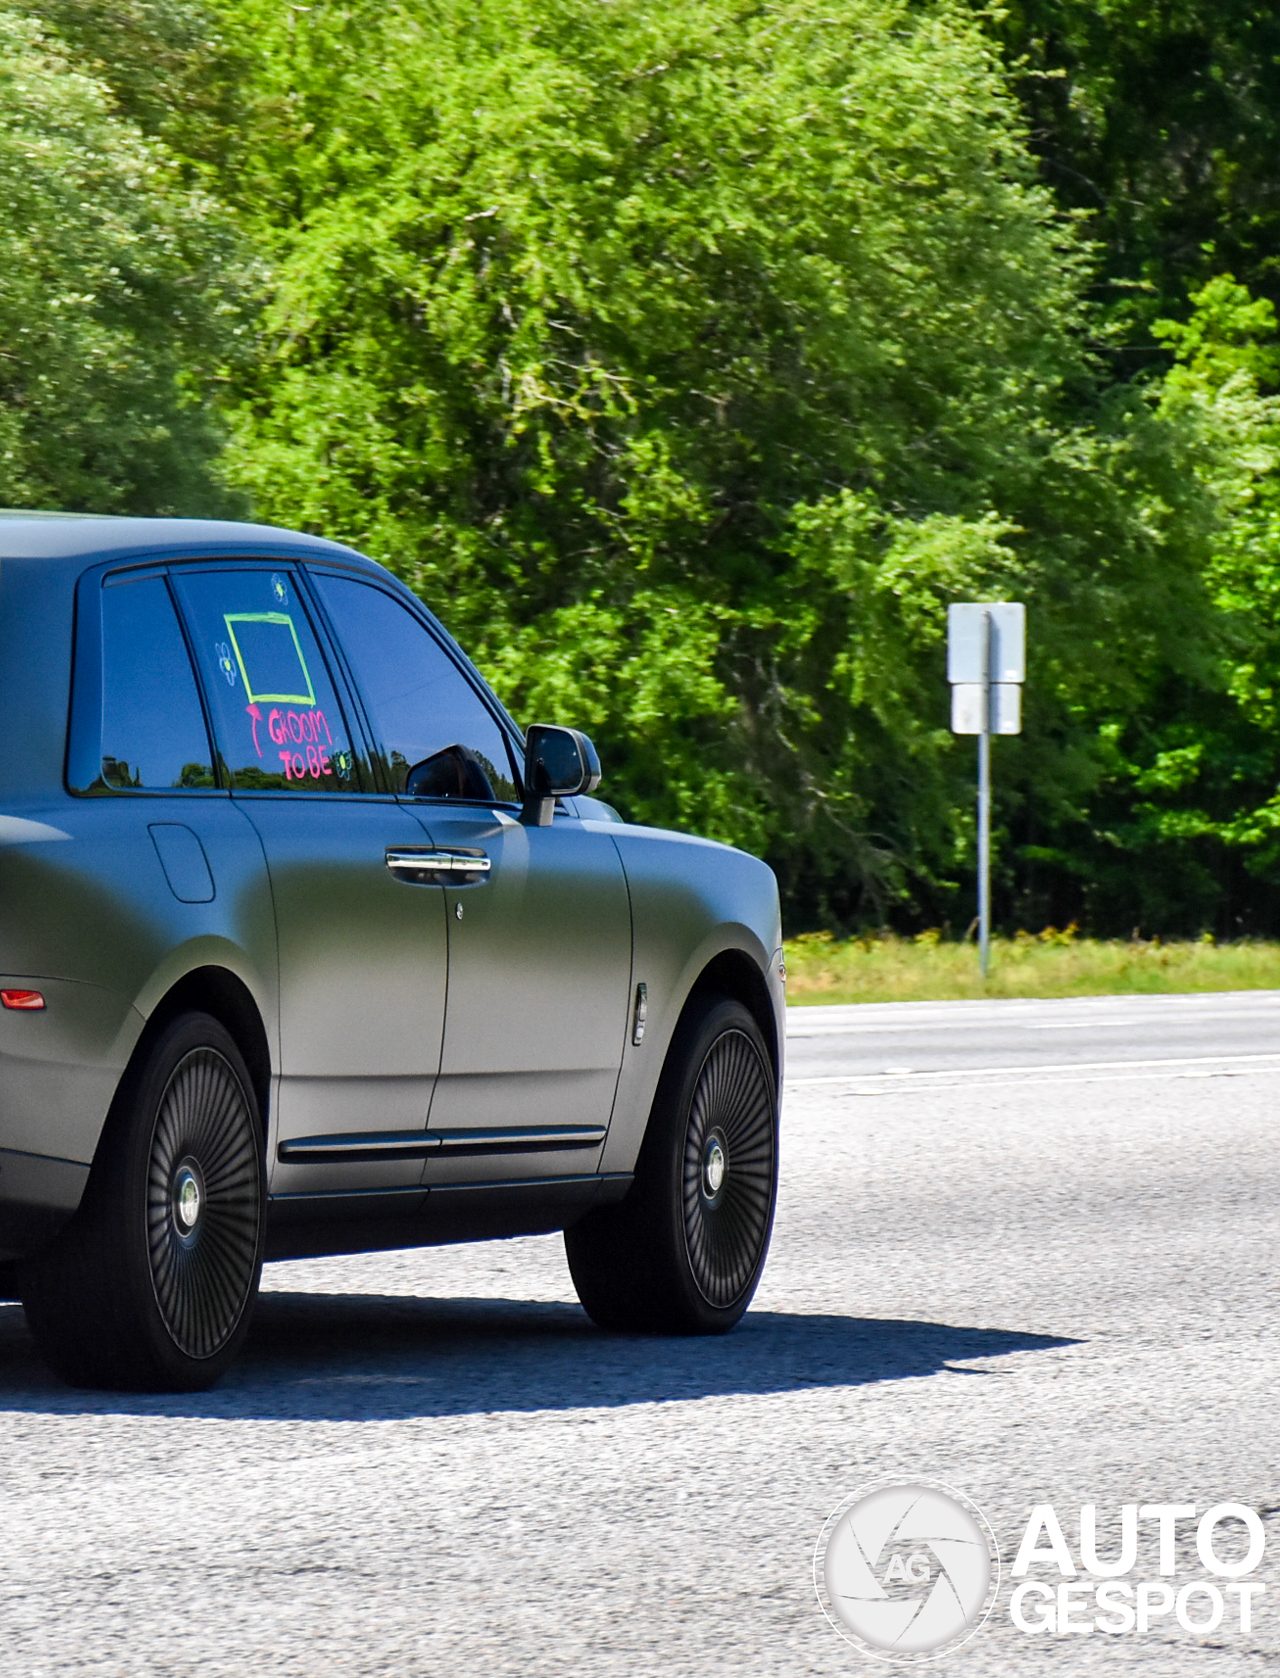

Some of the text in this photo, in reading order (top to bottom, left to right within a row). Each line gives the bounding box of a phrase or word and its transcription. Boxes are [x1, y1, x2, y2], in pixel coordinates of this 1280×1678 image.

[269, 709, 332, 745] GROOM
[279, 745, 332, 780] TO BE
